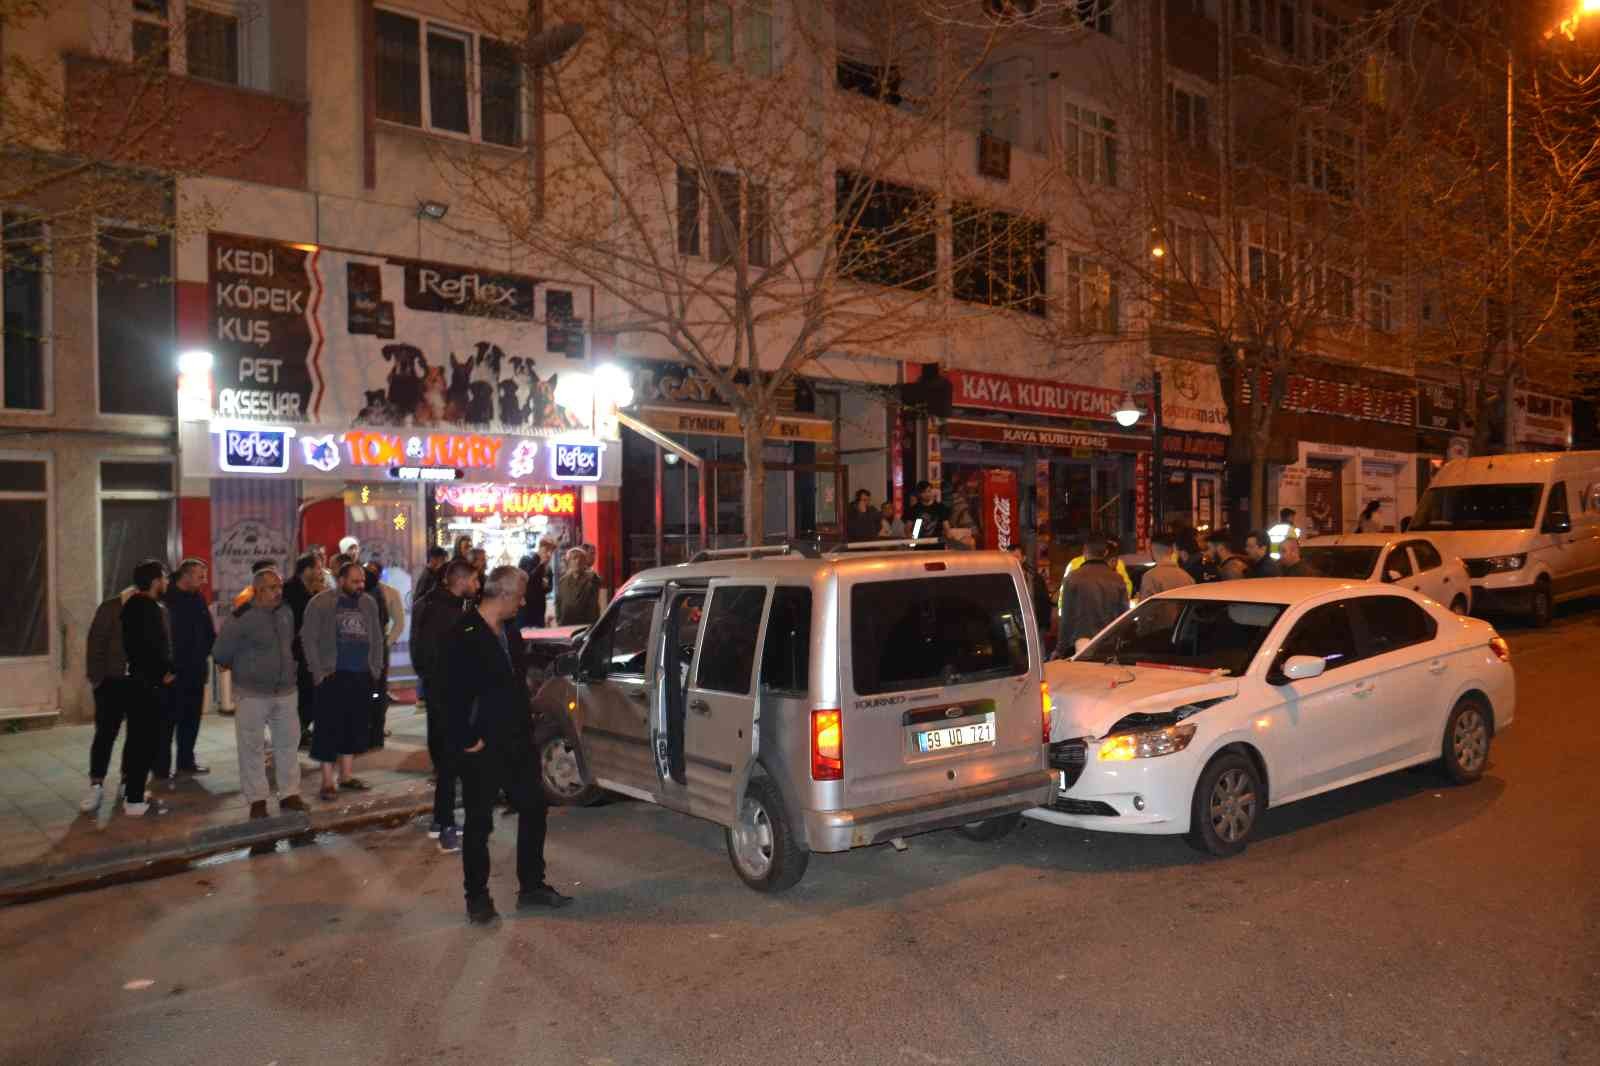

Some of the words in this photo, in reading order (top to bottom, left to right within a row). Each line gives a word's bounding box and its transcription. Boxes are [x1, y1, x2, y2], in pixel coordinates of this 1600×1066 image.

[216, 247, 274, 277] KEDİ
[216, 279, 303, 314] KÖPEK
[418, 268, 519, 305] Reflex
[217, 316, 272, 348] KUŞ
[238, 357, 283, 384] PET
[217, 387, 301, 418] AKSESUAR
[961, 374, 1012, 404] KAYA
[228, 430, 279, 461] Reflex
[345, 431, 406, 465] TOM
[406, 435, 424, 457] &
[422, 432, 502, 466] JERRY
[1002, 429, 1037, 444] KAYA
[558, 446, 594, 471] Reflex
[927, 732, 941, 748] 59
[970, 725, 990, 742] 721
